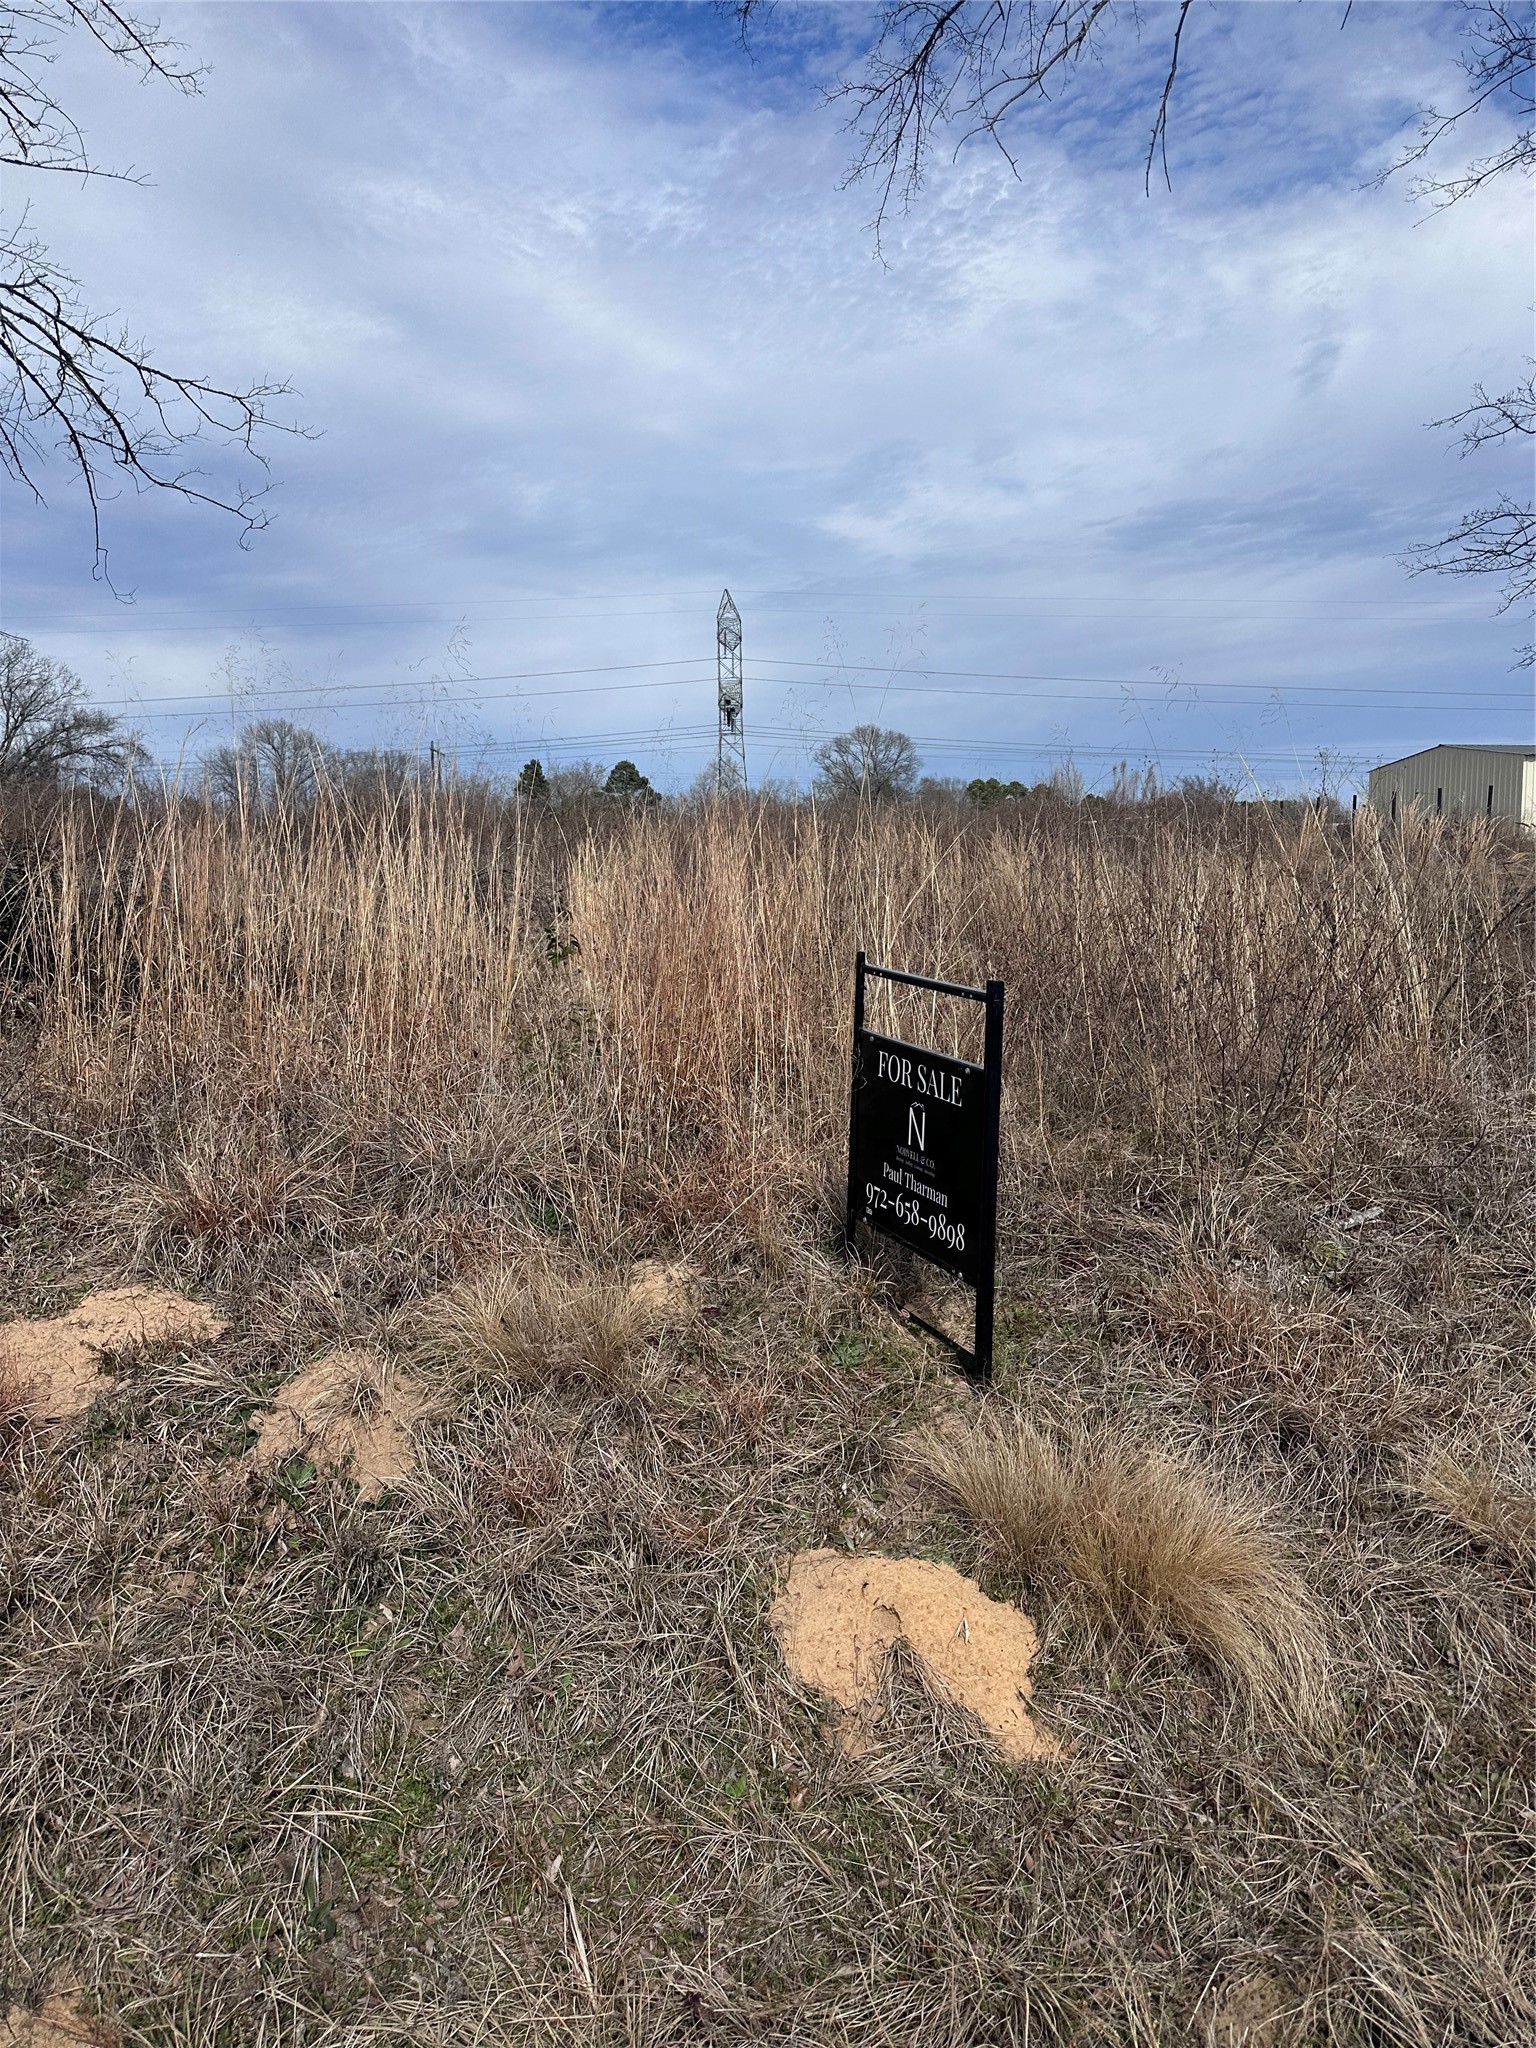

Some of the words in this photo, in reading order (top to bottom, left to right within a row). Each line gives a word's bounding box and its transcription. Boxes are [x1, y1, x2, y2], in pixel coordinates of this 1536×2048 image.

[878, 1051, 912, 1088] FOR
[917, 1064, 962, 1107] SALE
[883, 1161, 902, 1185] Paul
[904, 1172, 948, 1208] Tharman
[866, 1182, 965, 1251] 972-658-9898
